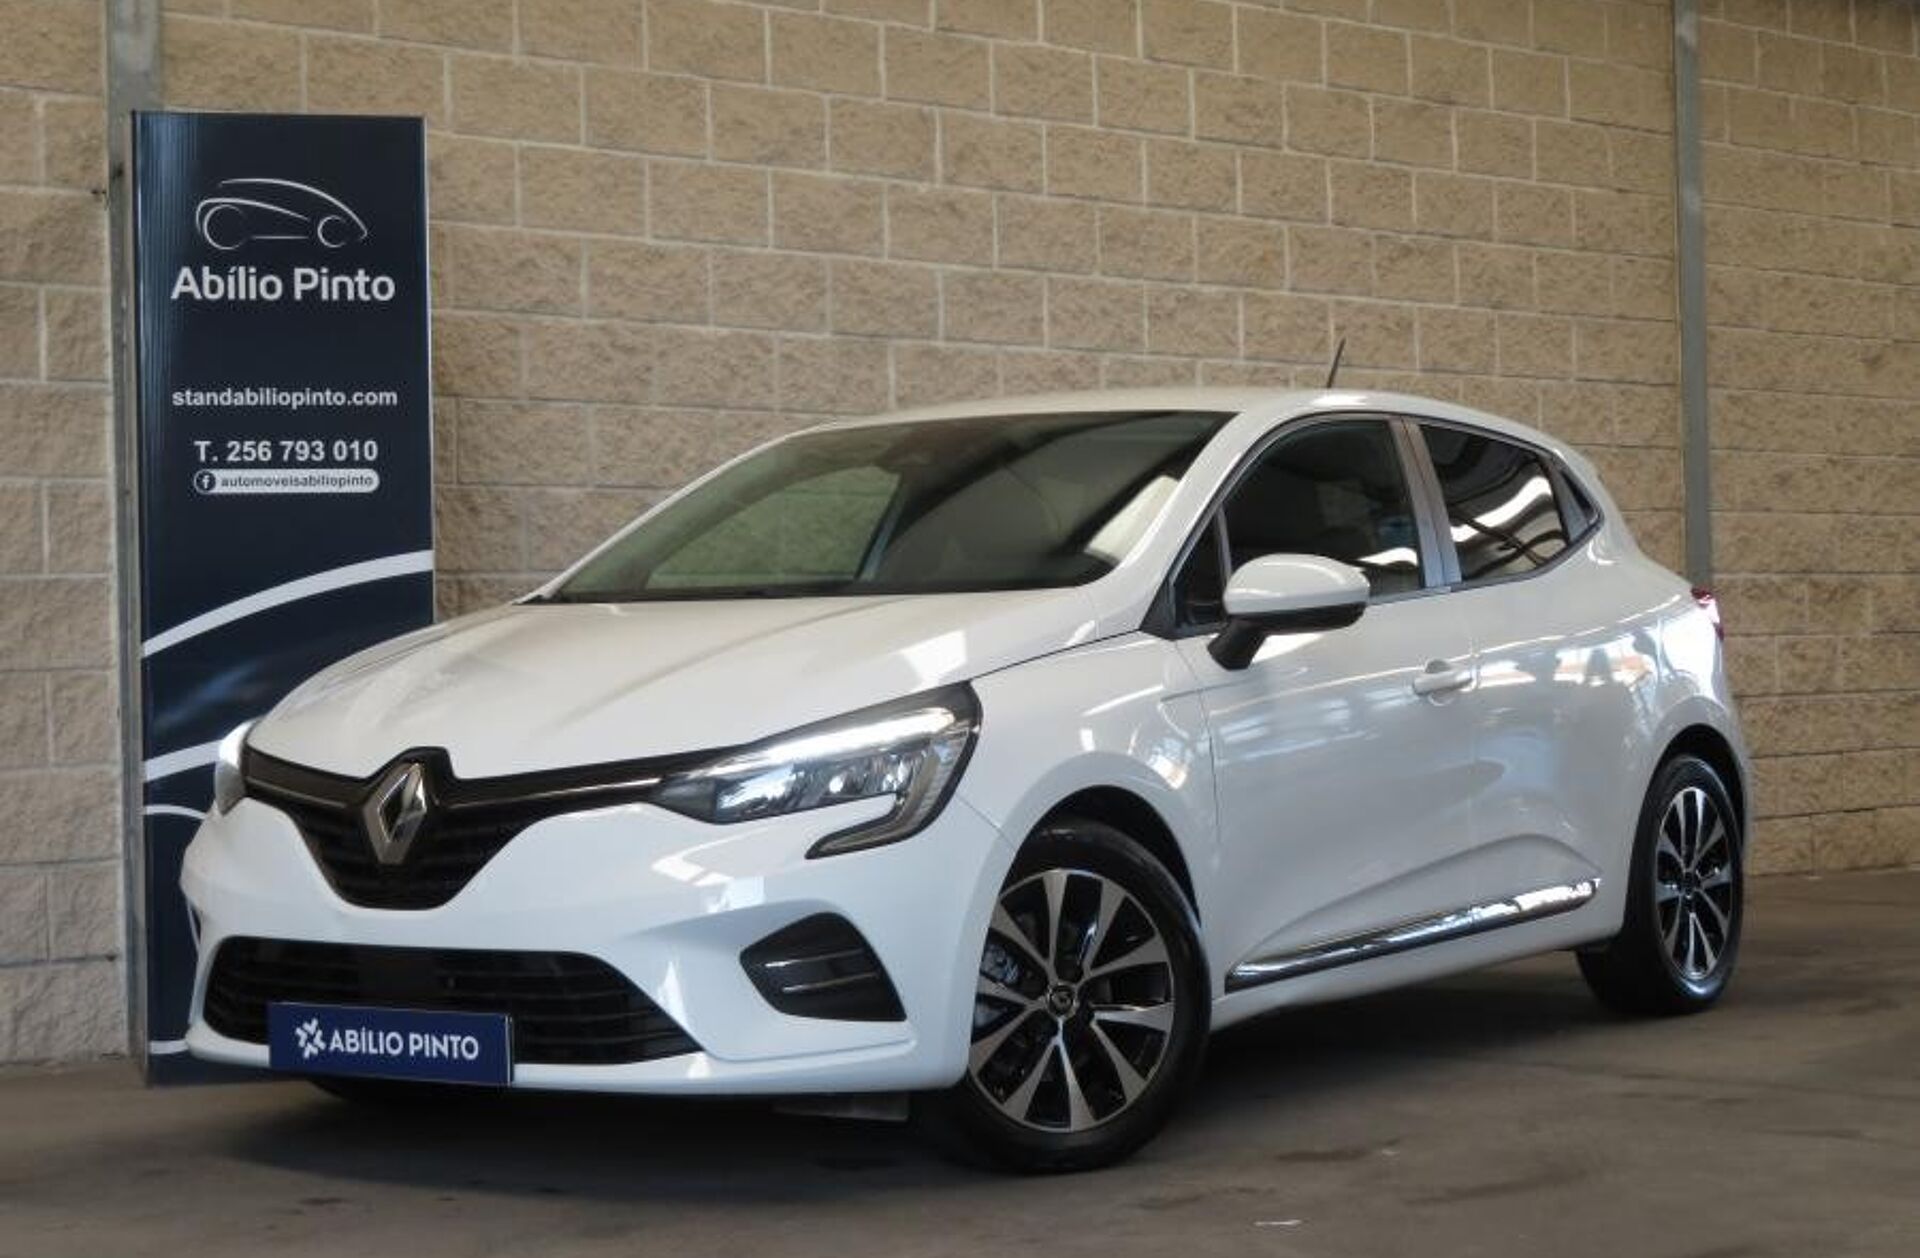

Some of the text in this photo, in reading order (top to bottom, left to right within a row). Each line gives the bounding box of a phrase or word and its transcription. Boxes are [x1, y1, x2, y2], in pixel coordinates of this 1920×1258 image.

[171, 266, 396, 301] Abílio Pinto
[172, 387, 398, 409] standabiliopinto.com
[194, 441, 378, 462] T. 256 793 010
[328, 1027, 479, 1060] ABÍLIO PINTO
